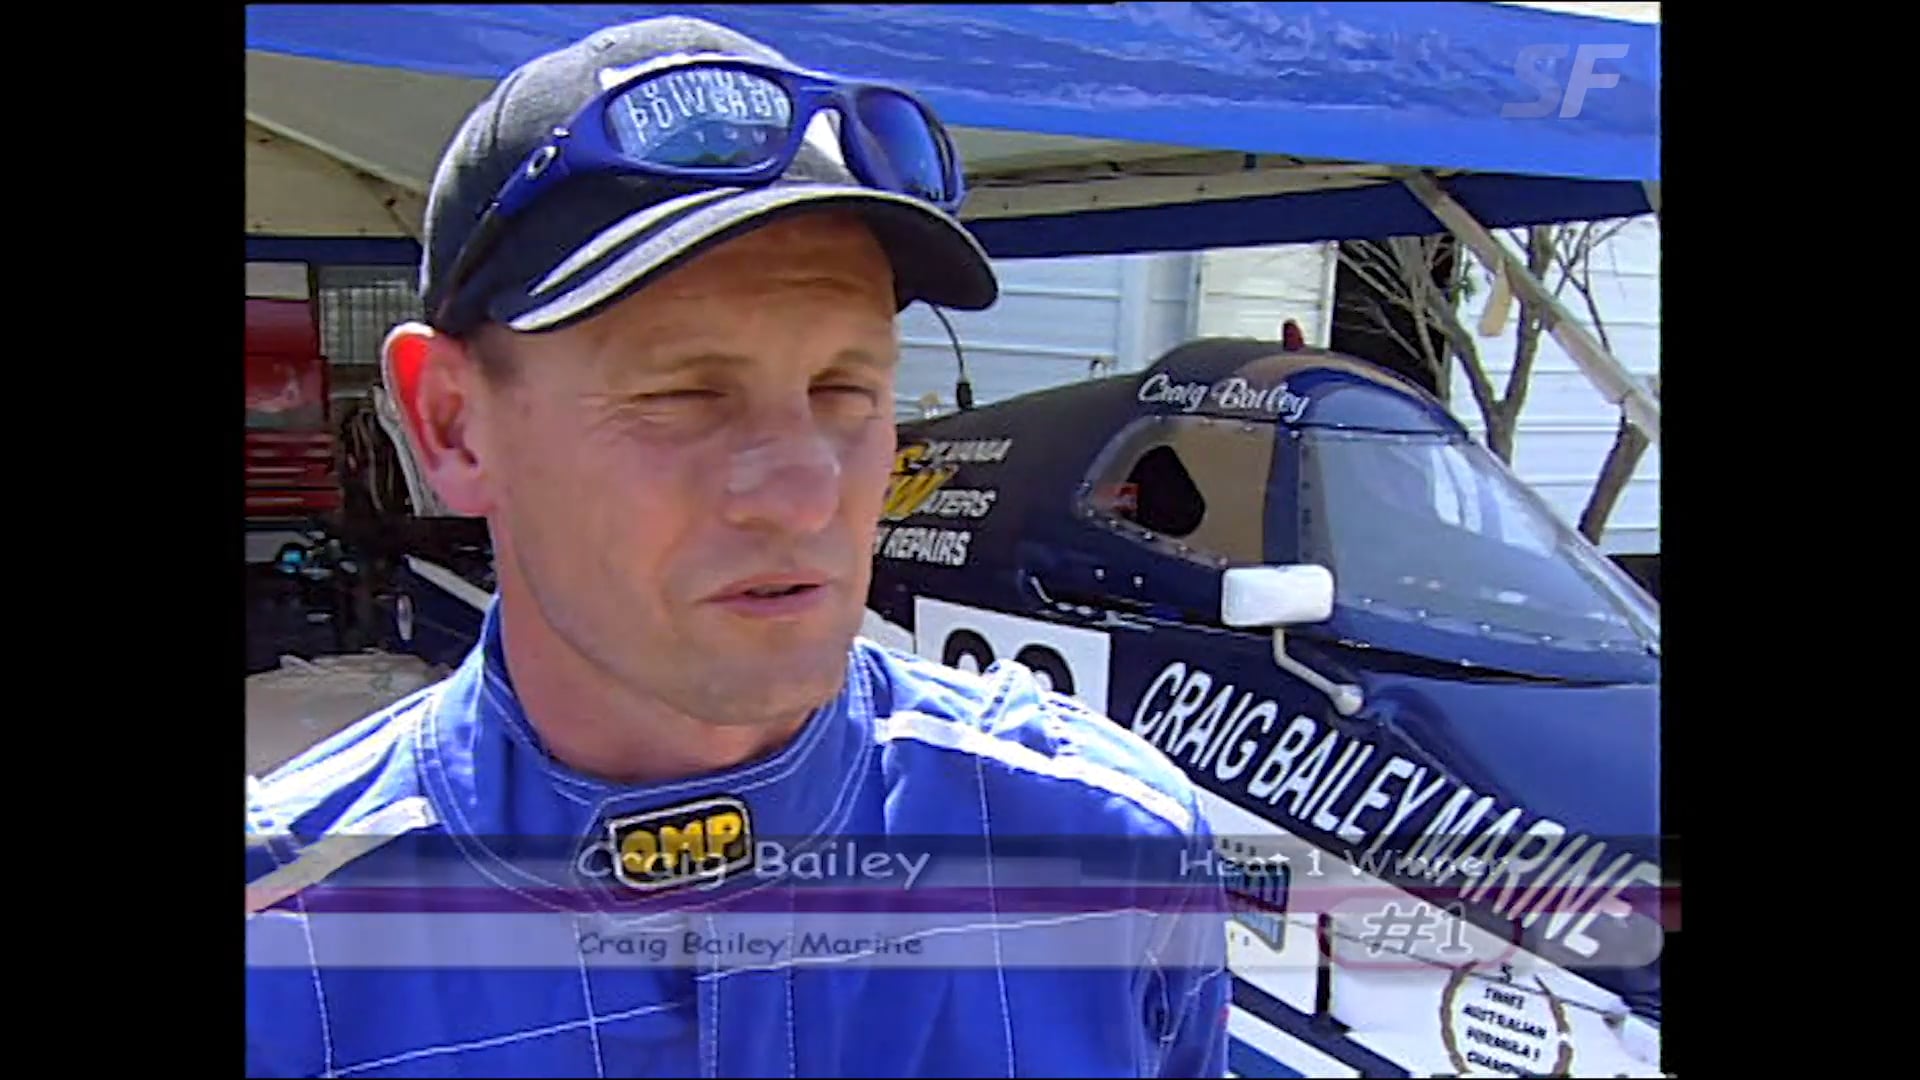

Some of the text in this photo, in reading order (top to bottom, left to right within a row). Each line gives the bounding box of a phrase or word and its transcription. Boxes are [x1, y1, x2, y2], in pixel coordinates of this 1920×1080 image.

[1138, 373, 1310, 423] Craig Bailey
[882, 527, 971, 566] REPAIRS
[1131, 661, 1277, 782] CRAIG
[1246, 714, 1446, 850] BAILEY
[1404, 790, 1660, 959] MARINE
[621, 811, 744, 875] OMP
[1462, 1004, 1548, 1040] AUSTRALIAN
